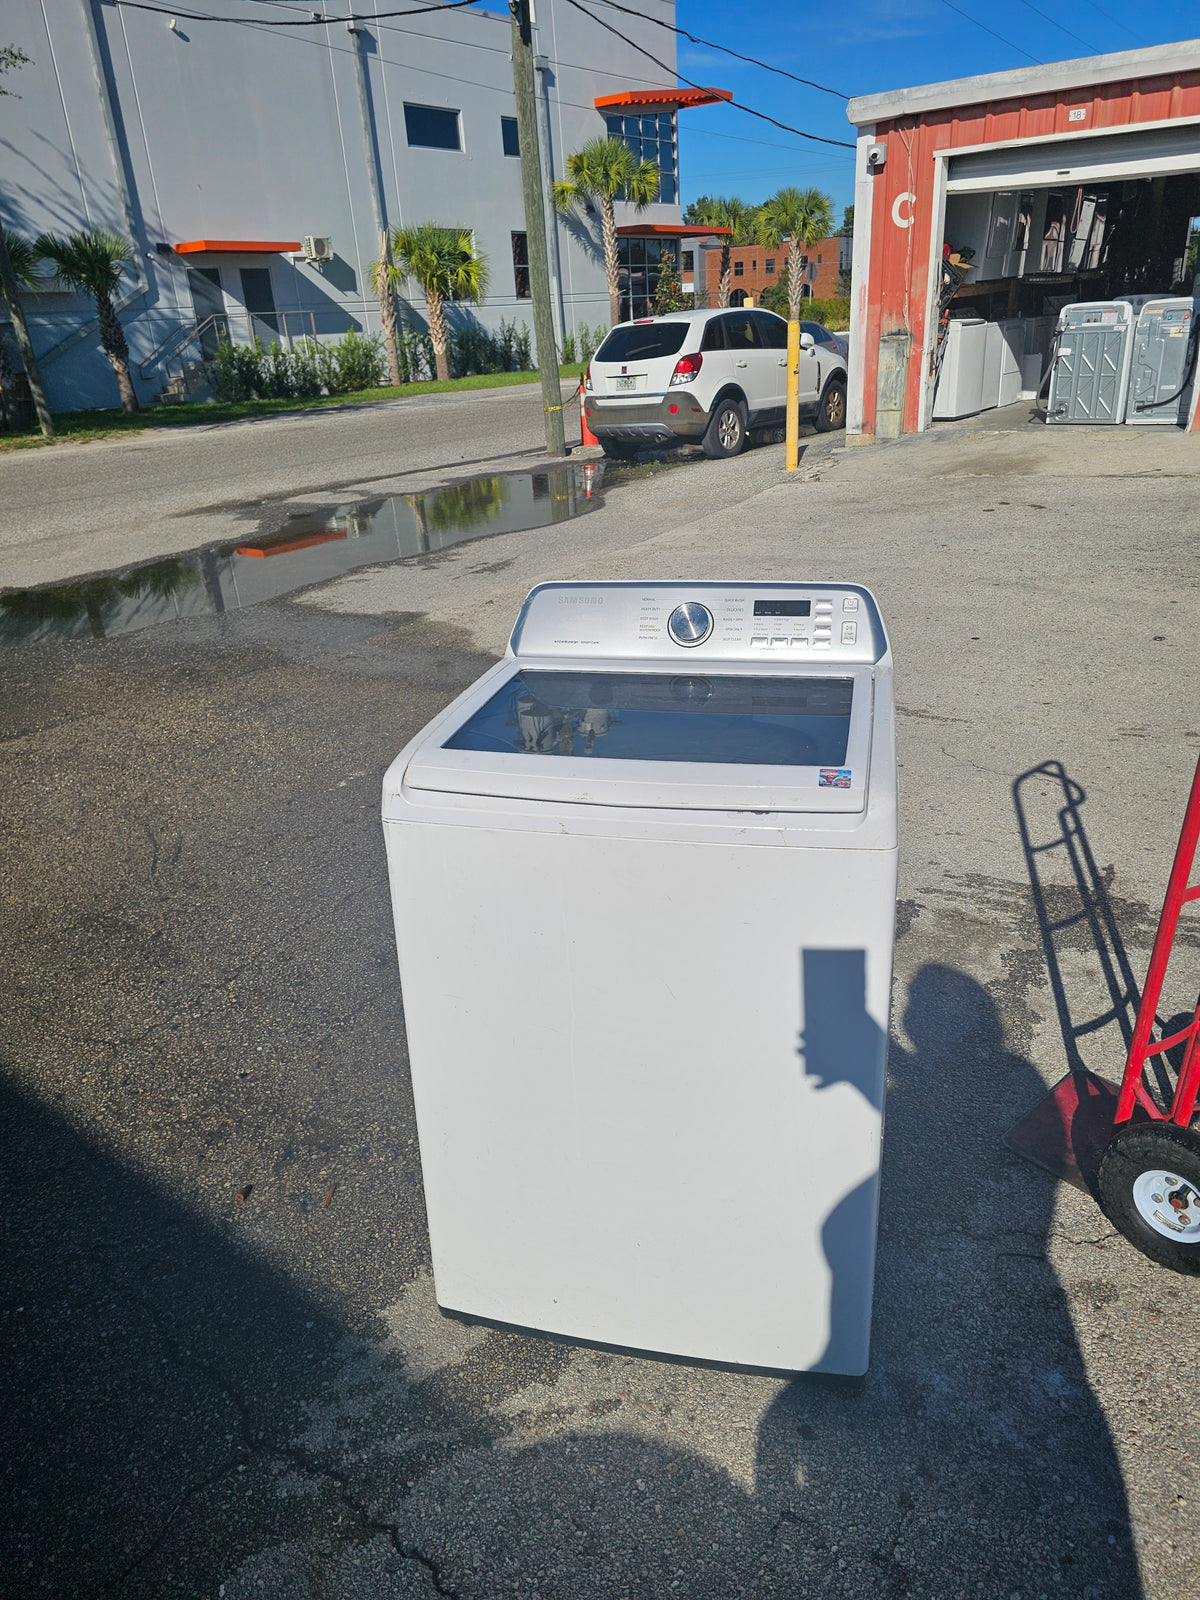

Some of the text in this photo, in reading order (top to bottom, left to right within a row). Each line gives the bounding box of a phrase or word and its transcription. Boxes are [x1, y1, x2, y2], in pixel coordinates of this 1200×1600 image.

[1073, 110, 1082, 120] 18
[891, 191, 917, 229] C
[558, 595, 604, 605] SAMSUNG
